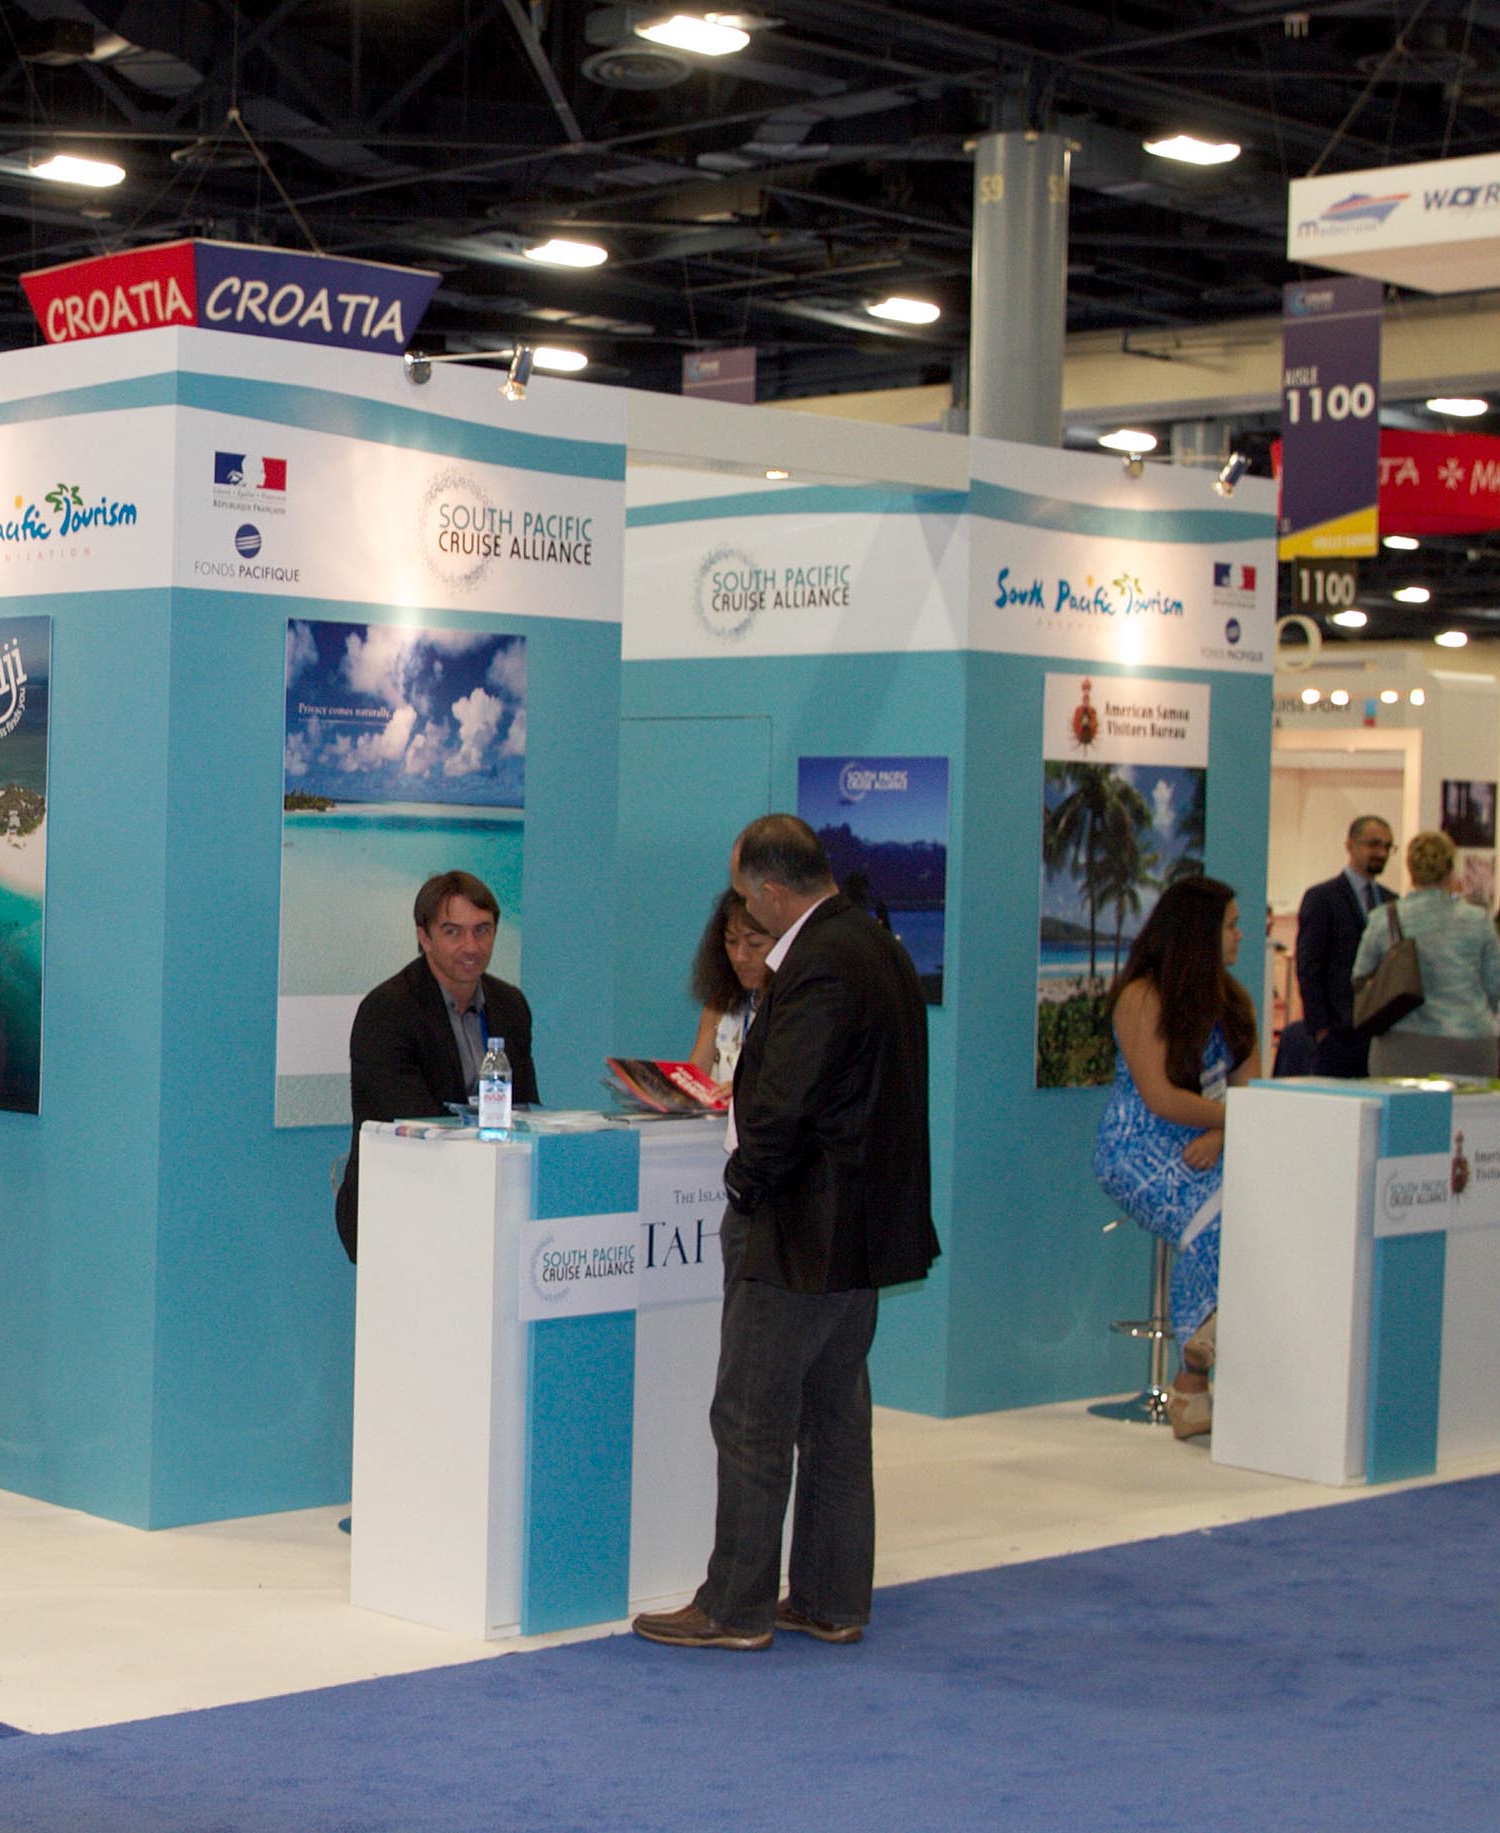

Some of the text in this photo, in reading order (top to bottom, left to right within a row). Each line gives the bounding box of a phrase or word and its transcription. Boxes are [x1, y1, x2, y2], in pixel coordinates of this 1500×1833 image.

[47, 277, 193, 343] CROATIA
[205, 276, 405, 344] CROATIA
[1286, 382, 1376, 425] 1100
[50, 487, 137, 537] Tourism
[439, 504, 593, 542] SOUTH PACIFIC
[438, 530, 592, 565] CRUISE ALLIANCE
[194, 561, 300, 582] FONDS PACIFIQUE
[712, 564, 850, 593] SOUTH PACIFIC
[1300, 568, 1357, 606] 1100
[711, 587, 850, 612] CRUISE ALLIANCE
[995, 567, 1044, 609] South
[1054, 579, 1116, 616] Pacific
[1114, 575, 1183, 616] Tourism
[1104, 702, 1190, 721] American Samoa
[1106, 720, 1187, 740] Visitors Bureau
[674, 1189, 696, 1205] THE
[542, 1260, 635, 1282] CRUISE ALLIANCE
[543, 1244, 636, 1269] SOUTH PACIFIC
